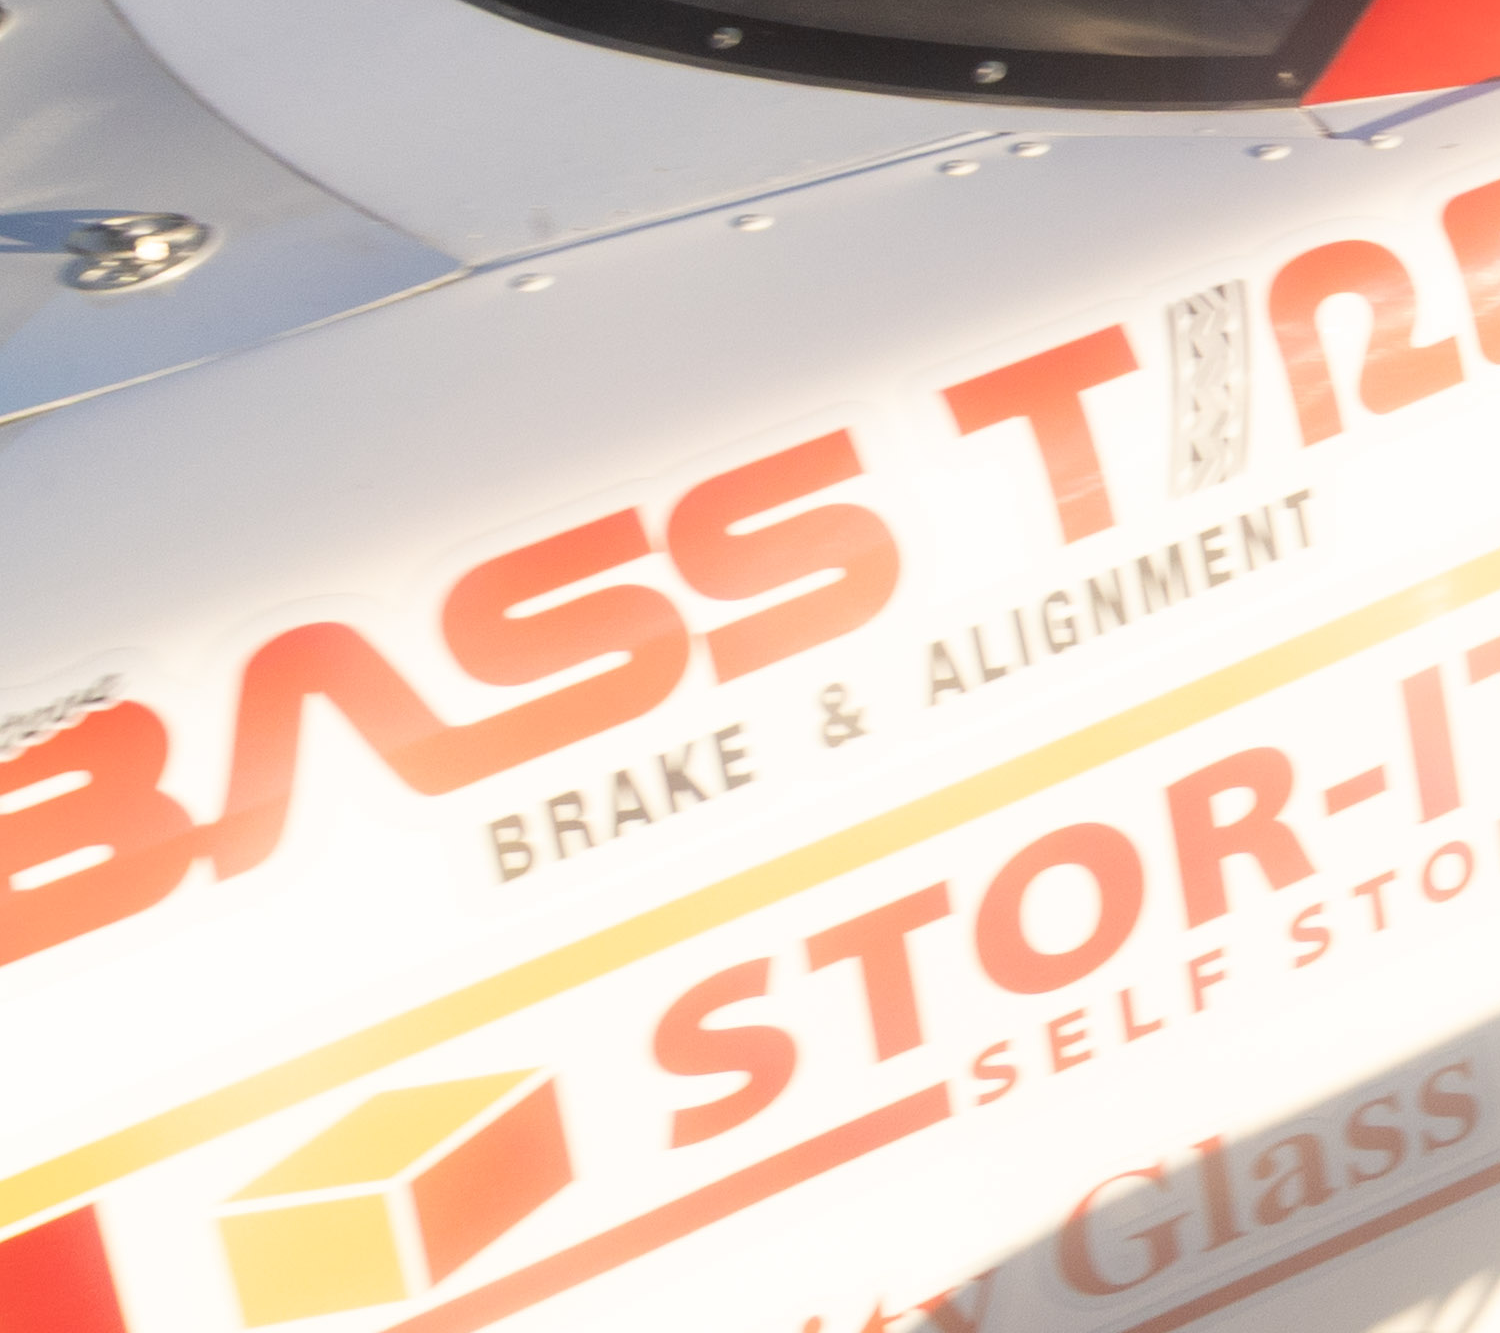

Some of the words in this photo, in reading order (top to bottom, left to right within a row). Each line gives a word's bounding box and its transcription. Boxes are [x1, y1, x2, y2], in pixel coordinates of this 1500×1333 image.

[0, 428, 902, 966] BASS
[489, 722, 758, 886] BRAKE
[819, 683, 868, 749] &
[925, 488, 1318, 707] ALIGNMENT
[970, 950, 1234, 1106] SELF
[1054, 1061, 1482, 1297] Glass
